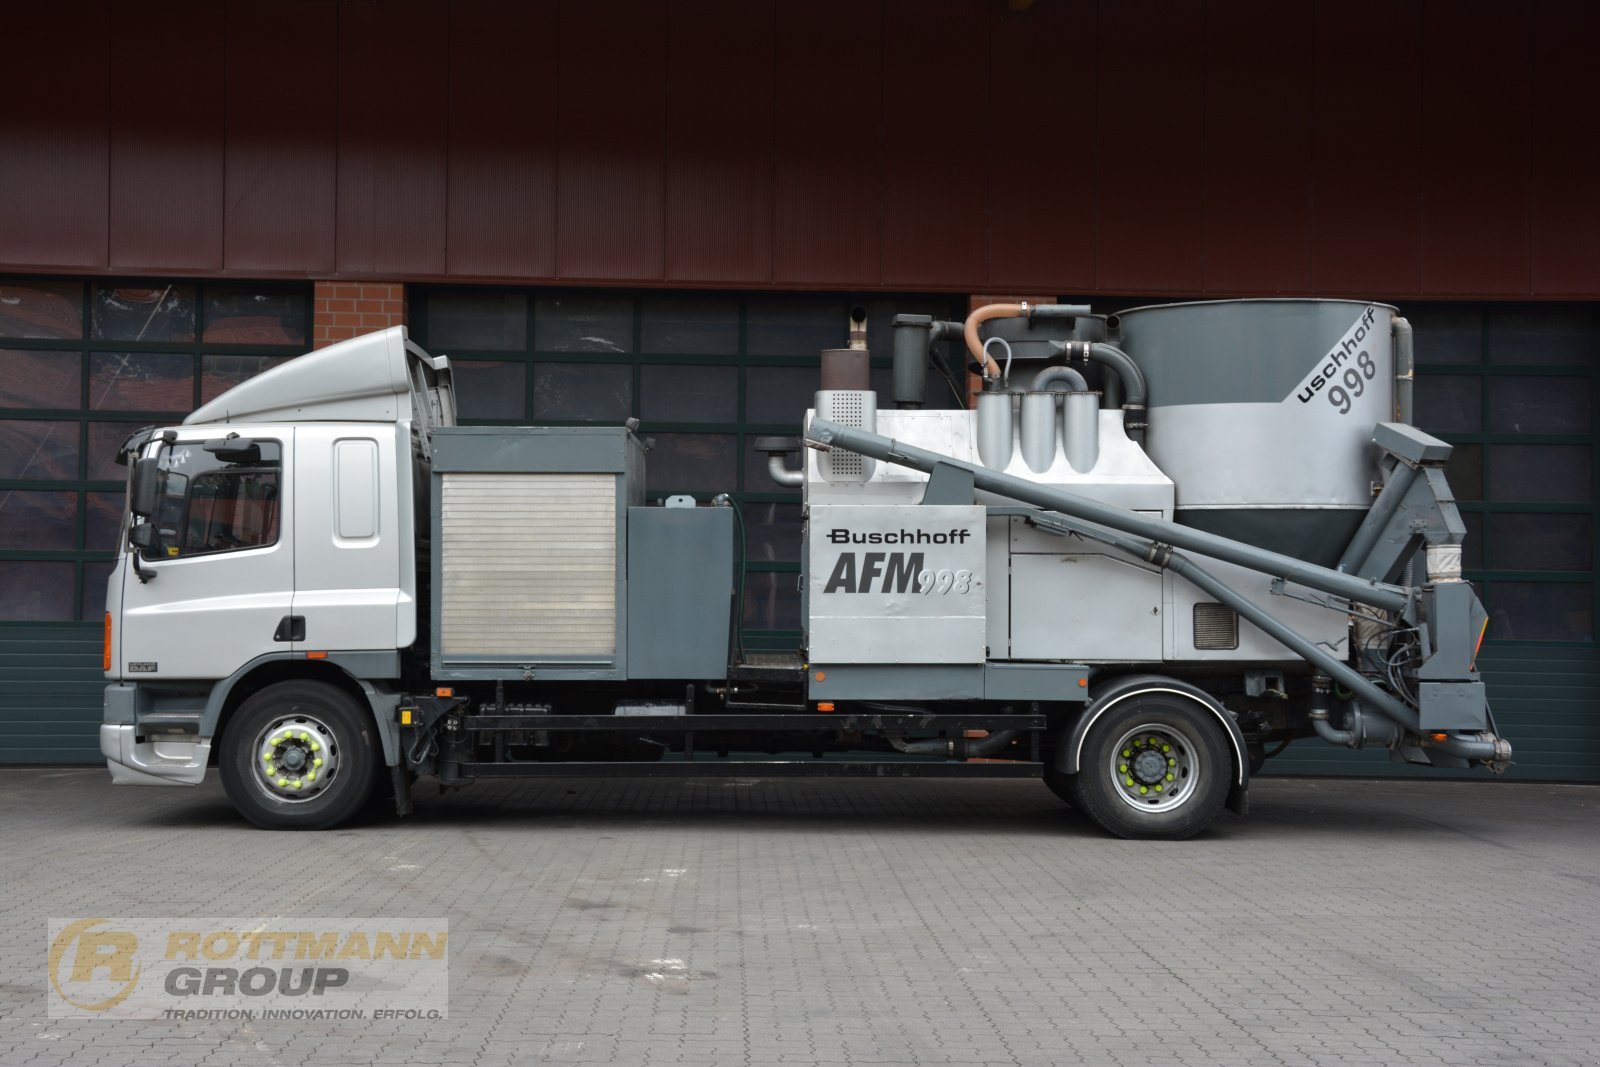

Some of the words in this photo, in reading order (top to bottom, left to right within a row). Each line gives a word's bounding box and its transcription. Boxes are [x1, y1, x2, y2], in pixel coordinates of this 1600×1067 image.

[1297, 307, 1375, 404] uschhoff
[1327, 350, 1376, 415] 998
[826, 529, 971, 544] Buschhoff
